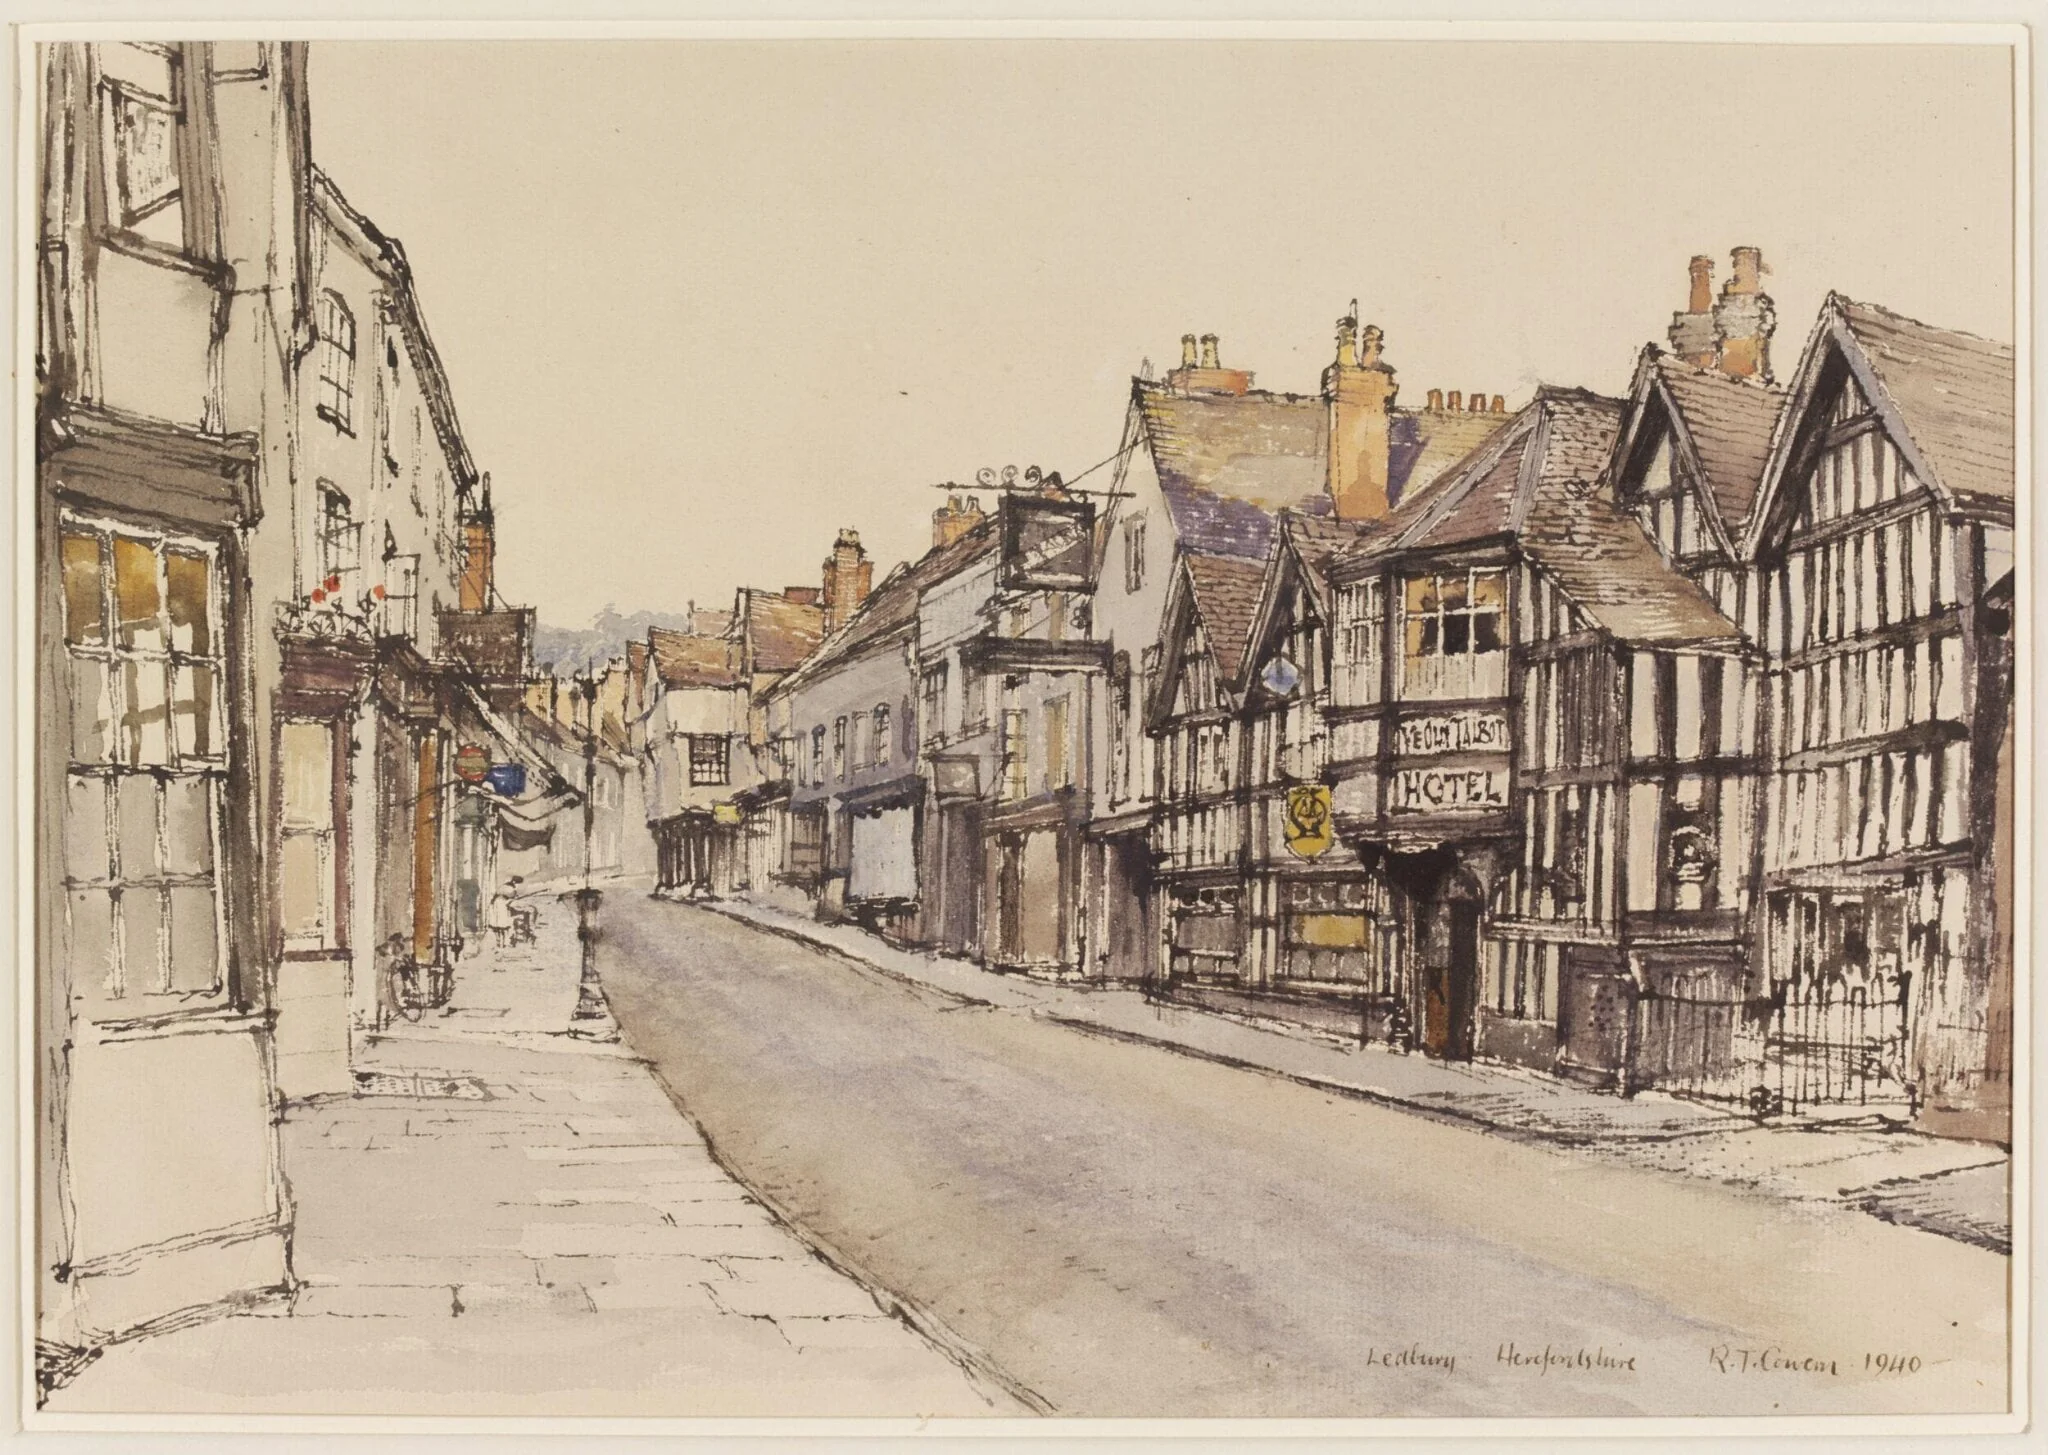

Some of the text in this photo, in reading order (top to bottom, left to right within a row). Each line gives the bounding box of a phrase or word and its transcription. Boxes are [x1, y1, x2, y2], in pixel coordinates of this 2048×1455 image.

[1449, 717, 1505, 750] TALBOT
[1403, 771, 1502, 806] HOTEL
[1367, 1341, 1636, 1376] Ledbury Herefordshire
[1864, 1351, 1922, 1377] 1940
